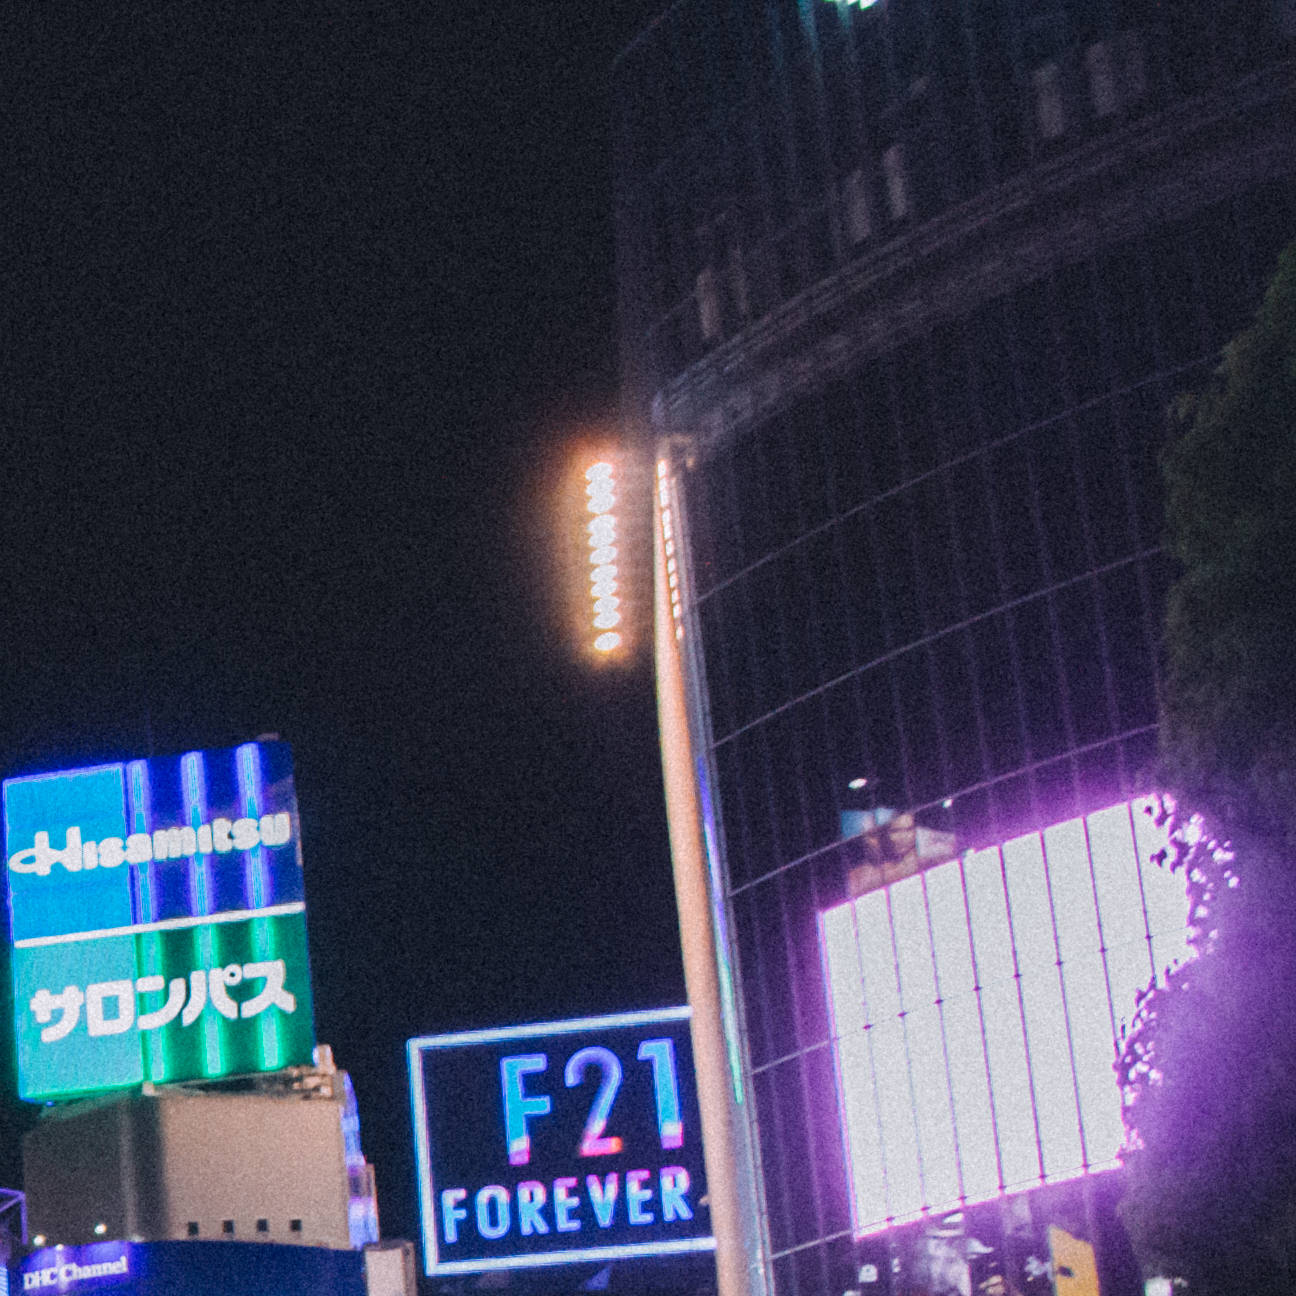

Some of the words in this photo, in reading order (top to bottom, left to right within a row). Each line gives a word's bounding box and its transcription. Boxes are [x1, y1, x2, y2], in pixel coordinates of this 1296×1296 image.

[30, 959, 296, 1043] サロンパス
[501, 1038, 684, 1166] F21
[441, 1166, 694, 1244] FOREVER
[60, 1255, 129, 1282] Channel
